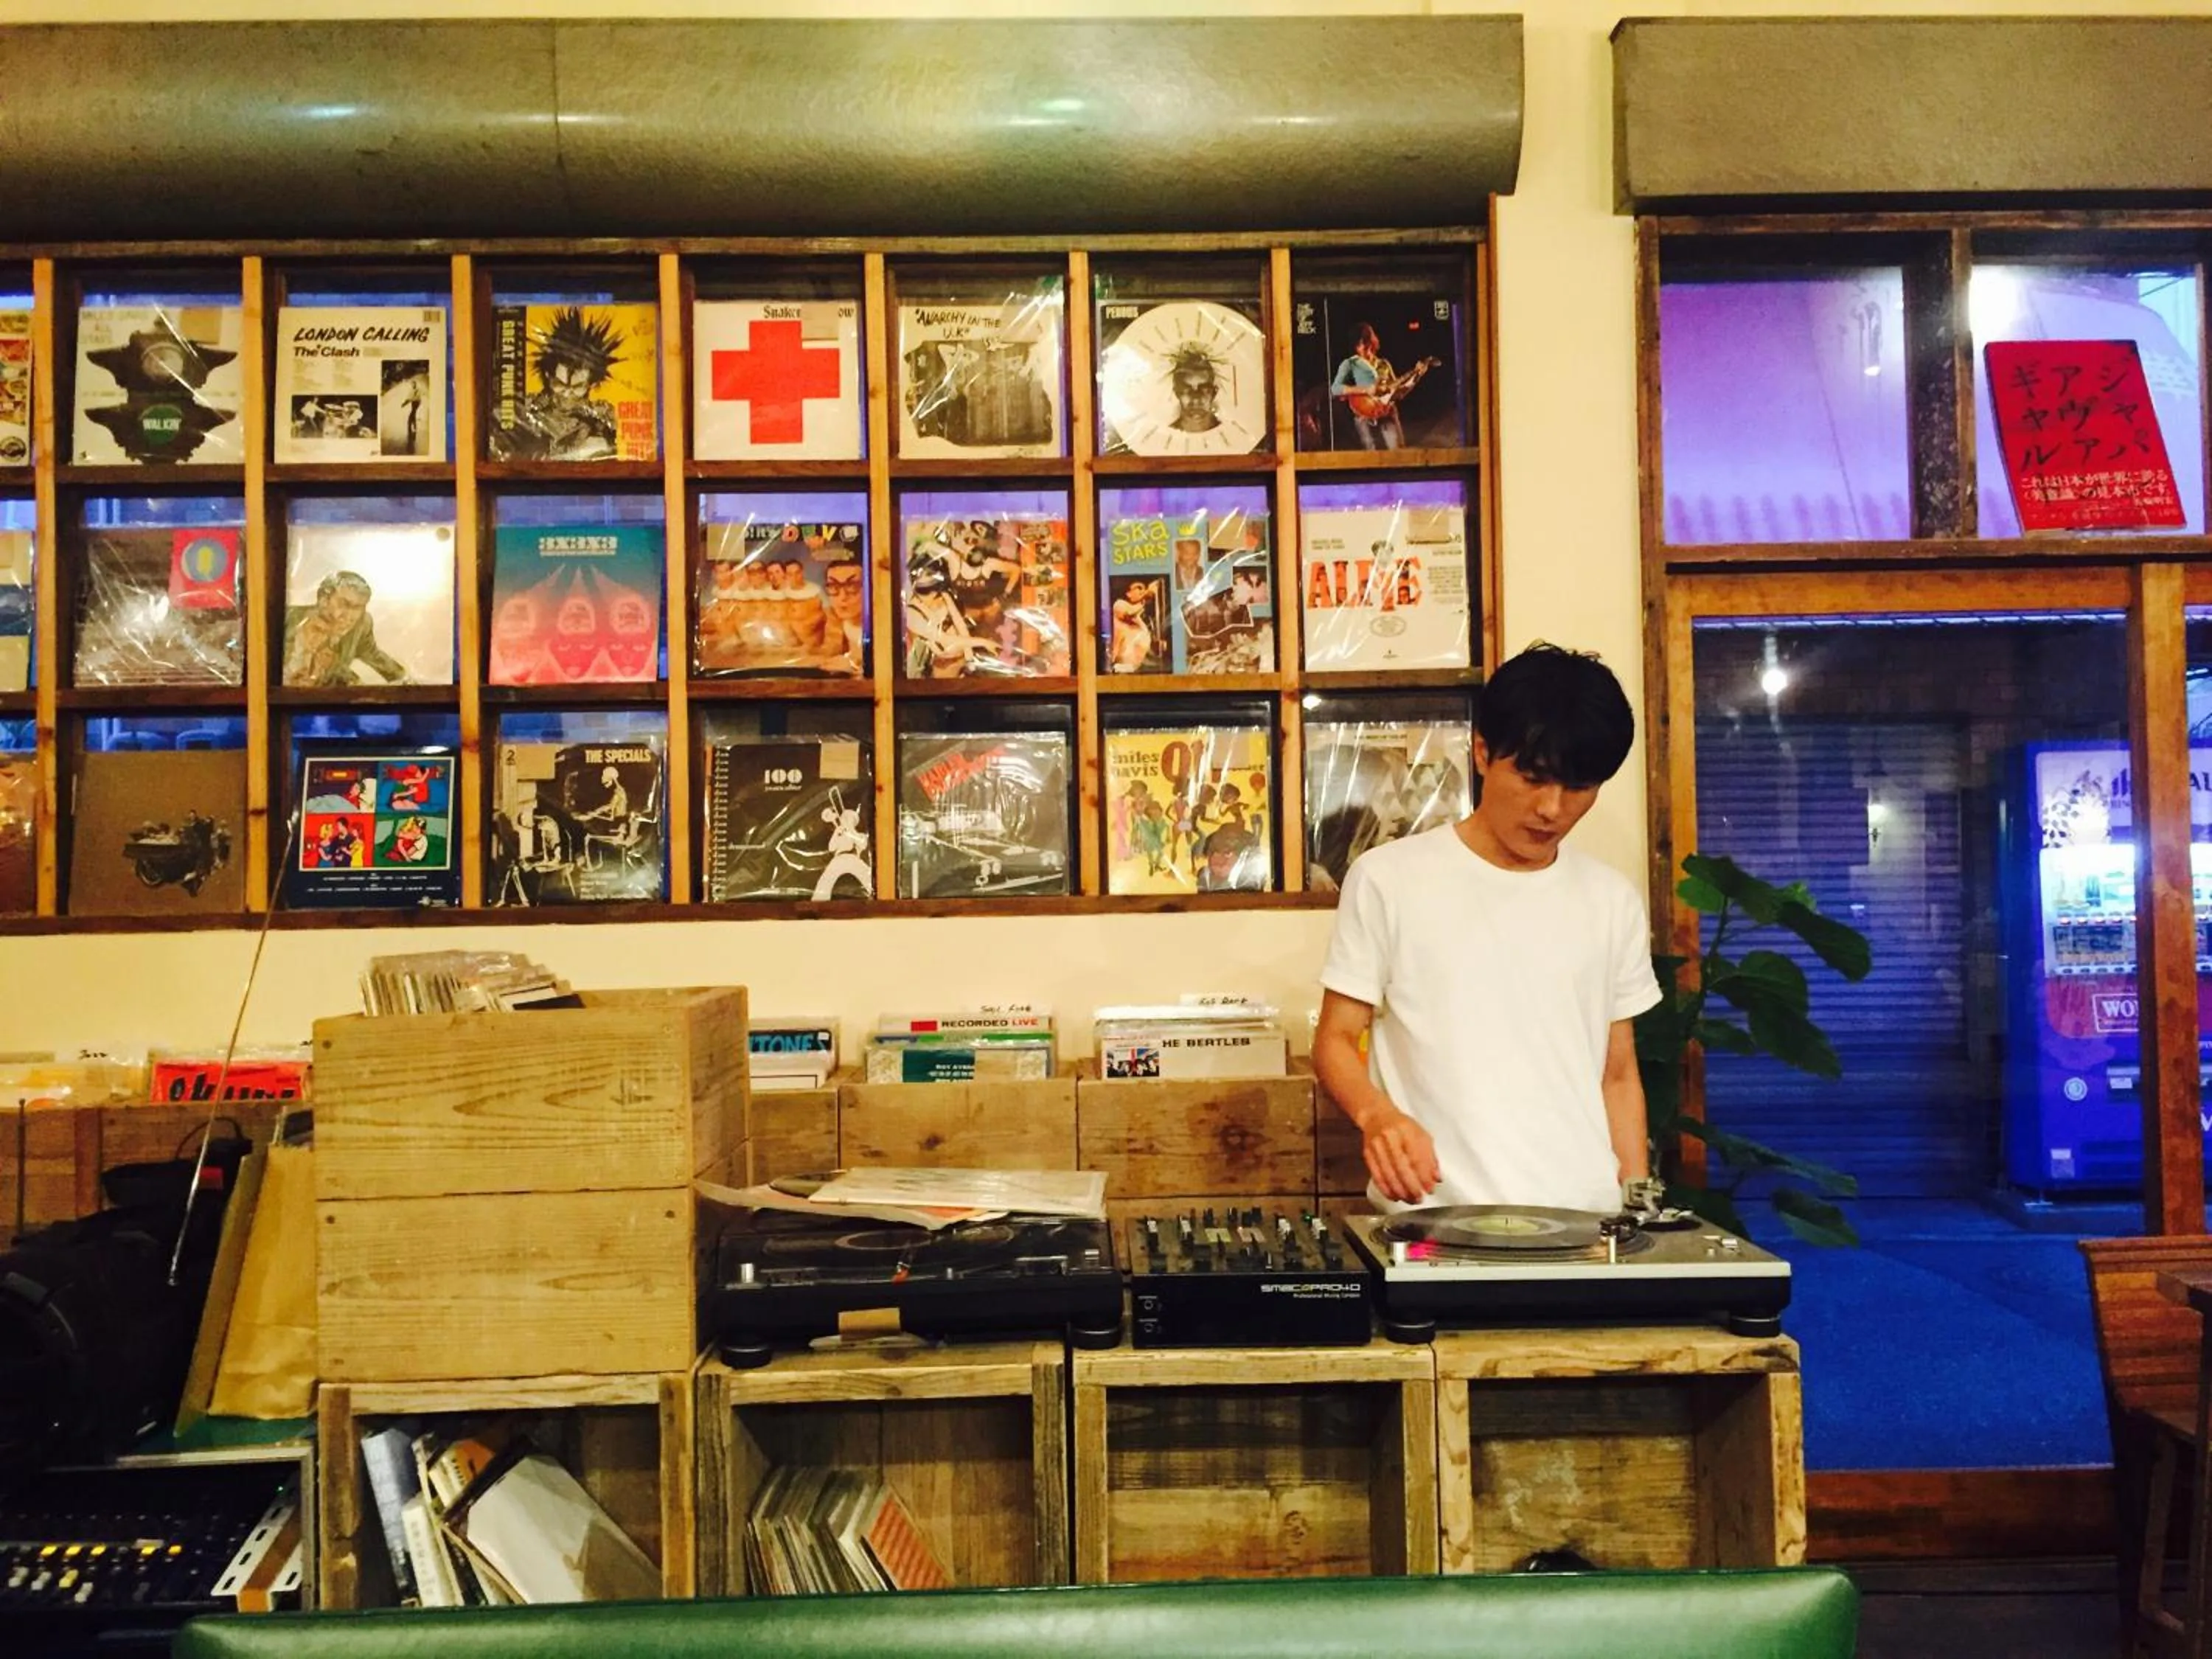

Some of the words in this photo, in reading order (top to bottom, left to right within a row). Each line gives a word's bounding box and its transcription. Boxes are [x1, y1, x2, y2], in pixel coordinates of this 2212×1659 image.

[293, 327, 359, 341] LONDON
[362, 327, 430, 342] CALLING
[293, 346, 319, 357] The
[321, 346, 360, 357] Clash
[1112, 541, 1169, 566] STARS
[585, 749, 603, 763] THE
[605, 748, 652, 763] SPECIALS
[765, 768, 803, 785] 100
[2101, 999, 2138, 1018] WO
[942, 1019, 1009, 1028] RECORDED
[1012, 1018, 1039, 1026] LIVE
[749, 1034, 829, 1053] TONES
[1162, 1039, 1180, 1048] HE
[1186, 1037, 1251, 1047] BEATLES
